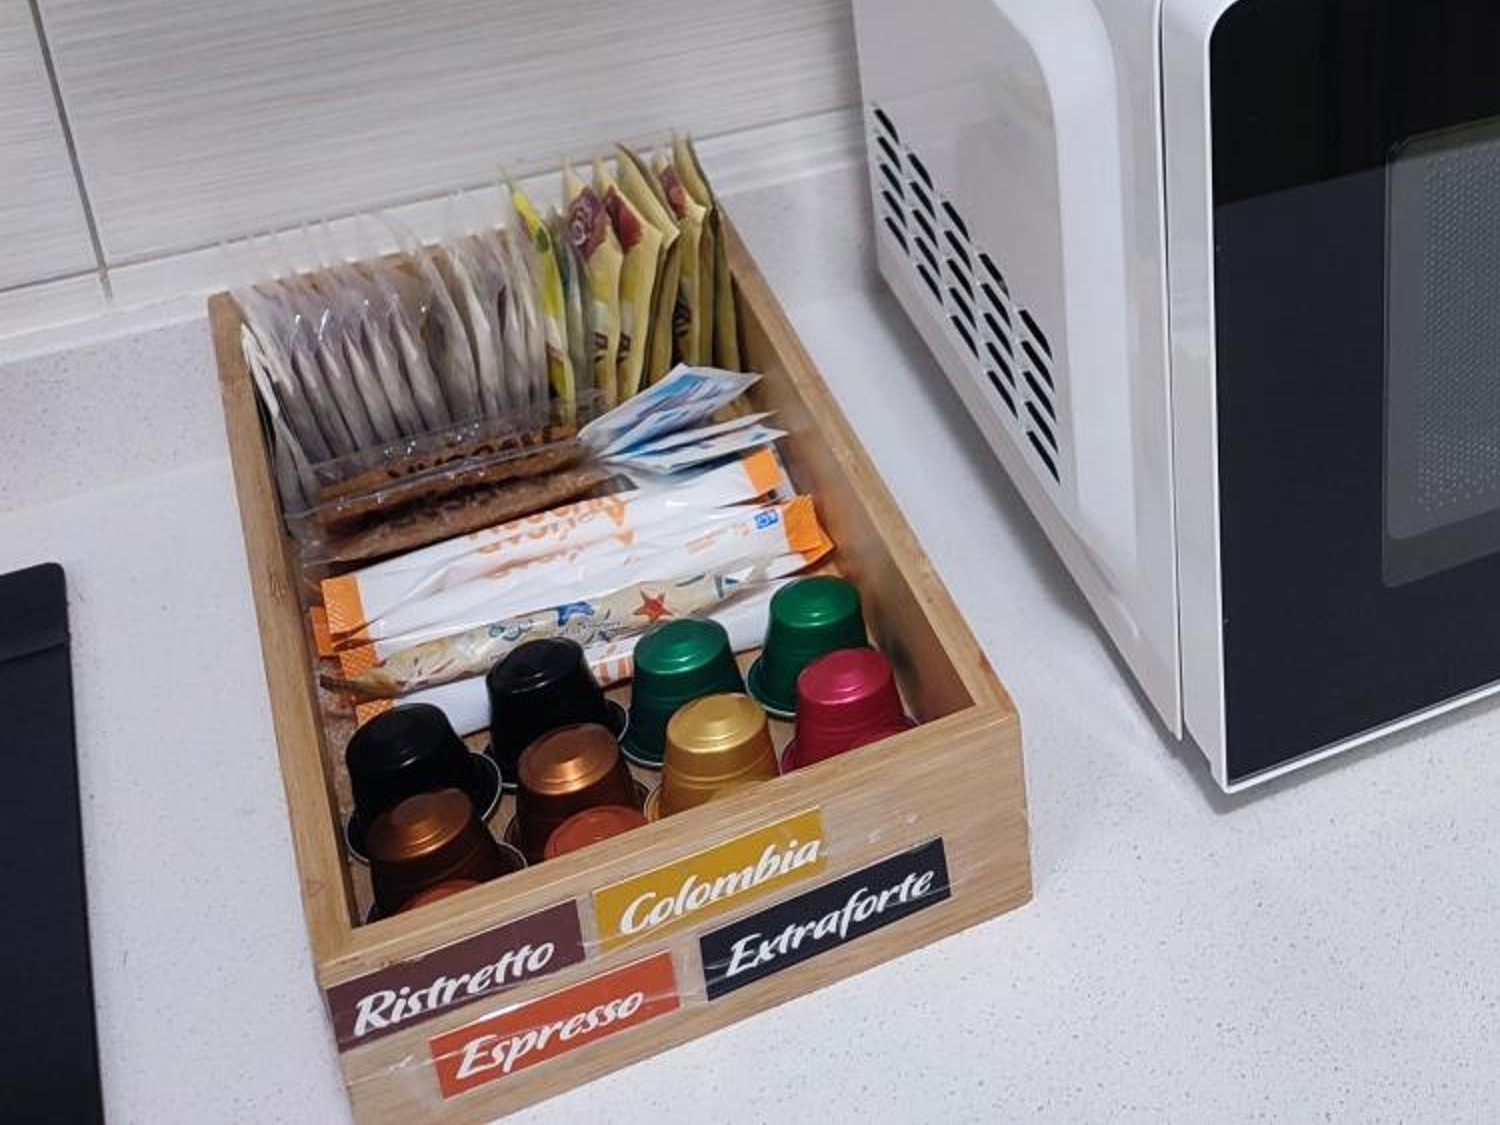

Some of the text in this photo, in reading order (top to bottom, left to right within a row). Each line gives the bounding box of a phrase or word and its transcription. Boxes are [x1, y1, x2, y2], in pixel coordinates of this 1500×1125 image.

[618, 838, 822, 936] Colombia
[726, 869, 936, 977] Extraforte
[352, 941, 555, 1038] Ristretto
[455, 991, 645, 1080] Espresso
